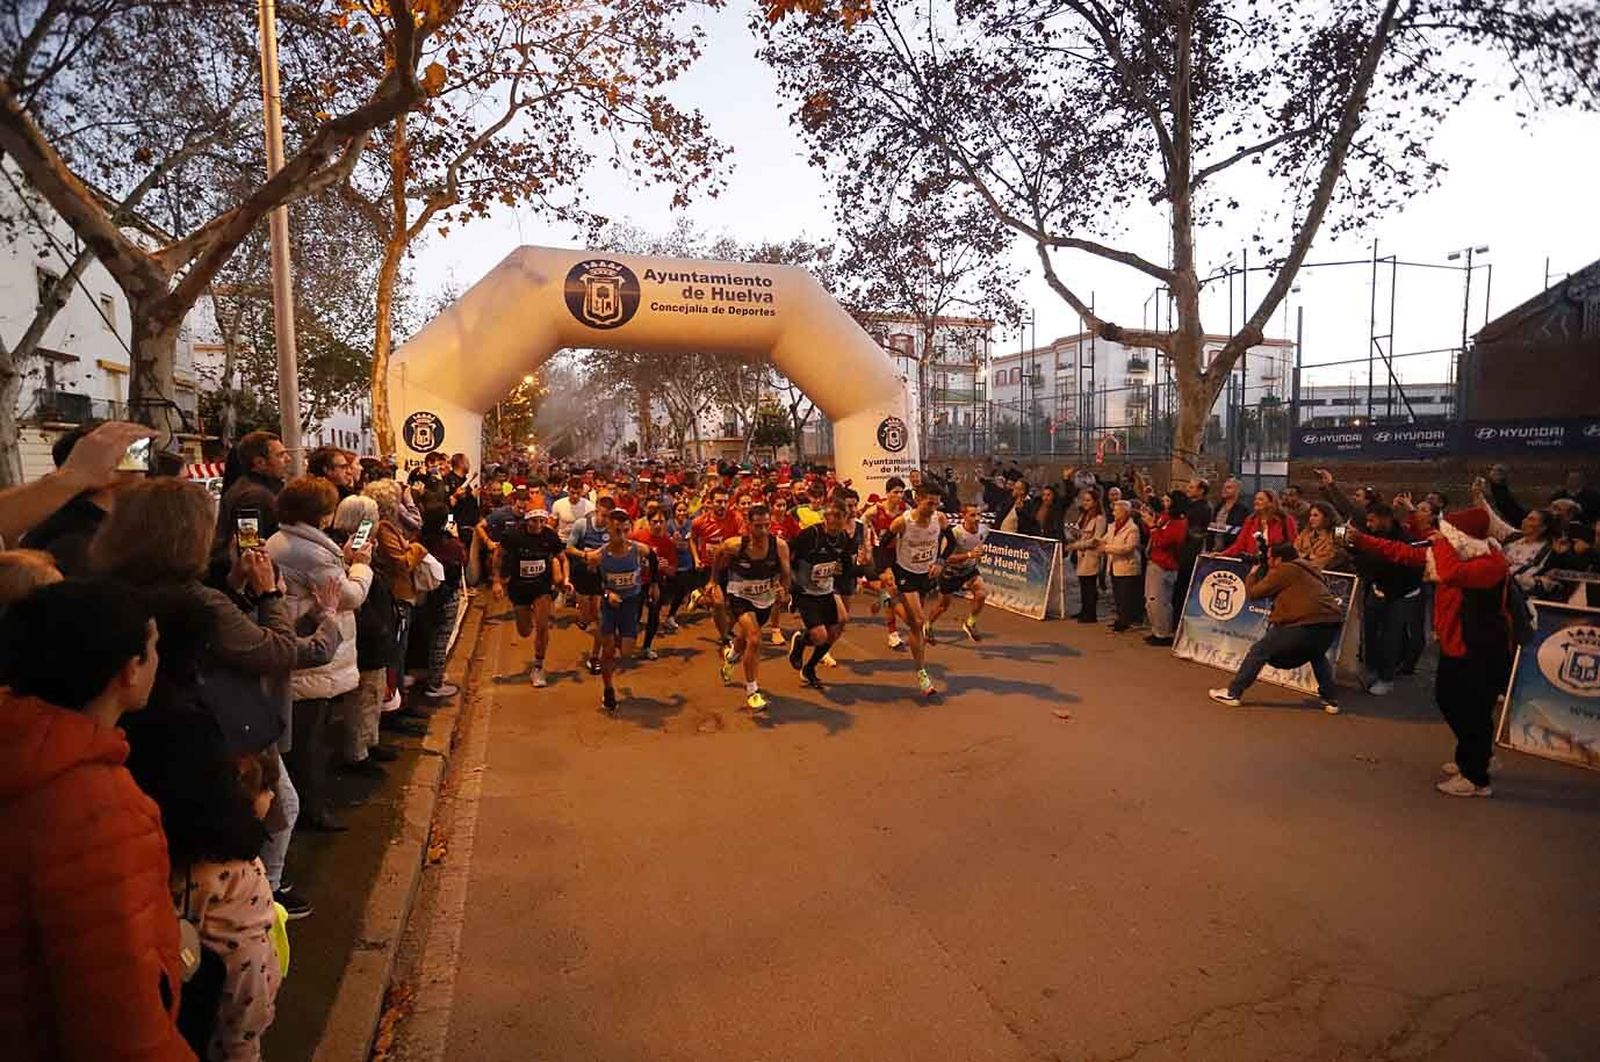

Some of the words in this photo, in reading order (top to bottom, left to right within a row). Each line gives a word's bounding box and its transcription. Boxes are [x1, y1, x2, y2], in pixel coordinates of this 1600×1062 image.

[643, 268, 773, 287] Ayuntamiento
[682, 286, 705, 300] de
[711, 287, 774, 303] Huelva
[711, 306, 725, 315] de
[728, 306, 776, 316] Deportes
[1394, 430, 1445, 441] HYUNDAI
[1499, 426, 1565, 437] HYUNDAI
[1319, 433, 1362, 442] HYUNDAI
[980, 553, 993, 566] de
[994, 556, 1028, 573] Huelva
